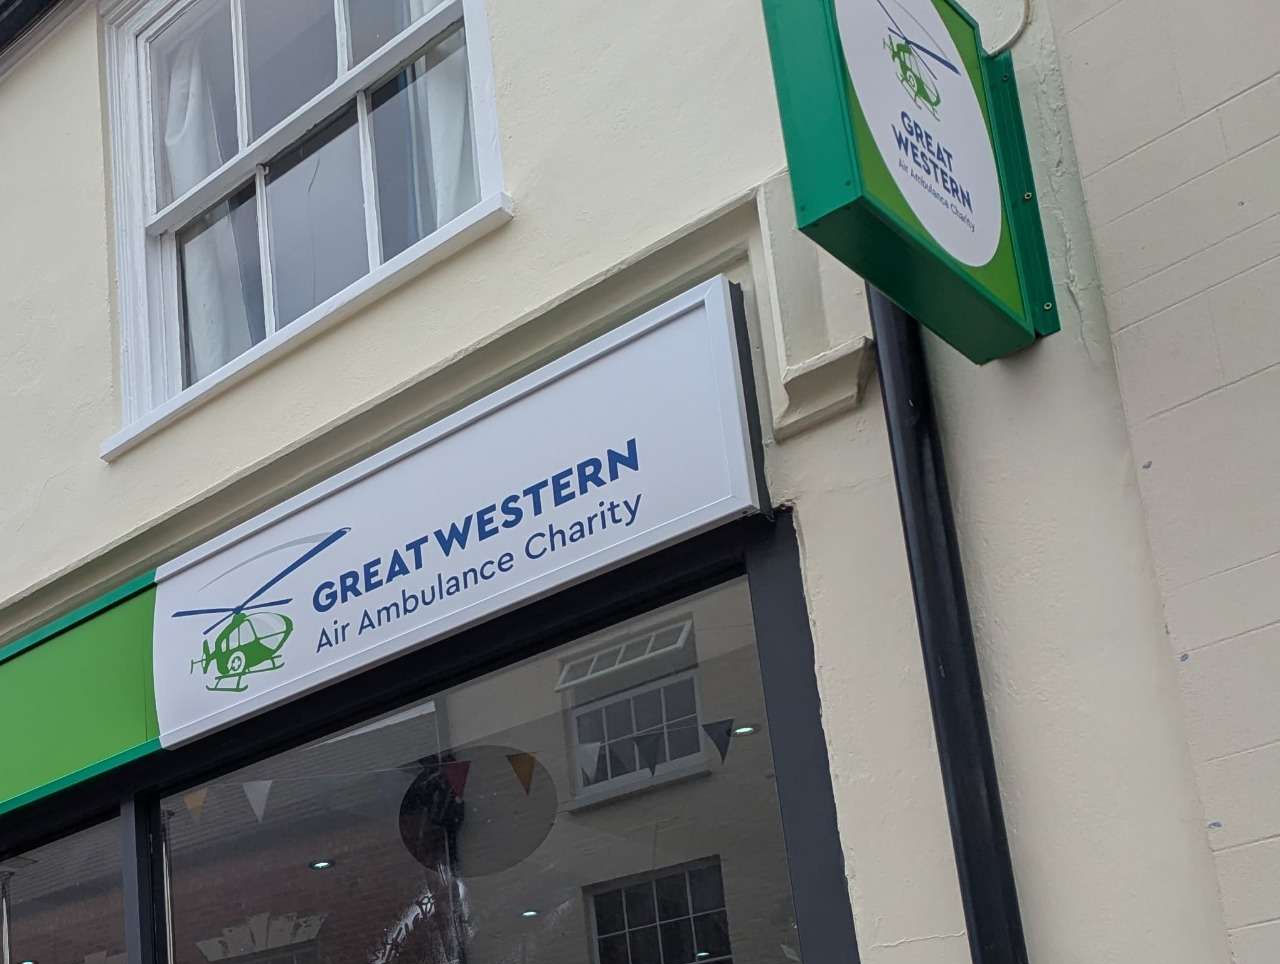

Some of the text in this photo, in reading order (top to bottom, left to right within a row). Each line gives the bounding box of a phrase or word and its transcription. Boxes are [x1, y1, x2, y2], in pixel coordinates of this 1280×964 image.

[891, 123, 974, 214] WESTERN
[901, 111, 953, 173] GREAT
[910, 168, 949, 209] Ambulance
[950, 203, 975, 233] Charity
[312, 437, 640, 613] GREAT WESTERN
[316, 494, 642, 653] Air Ambulance Charity
